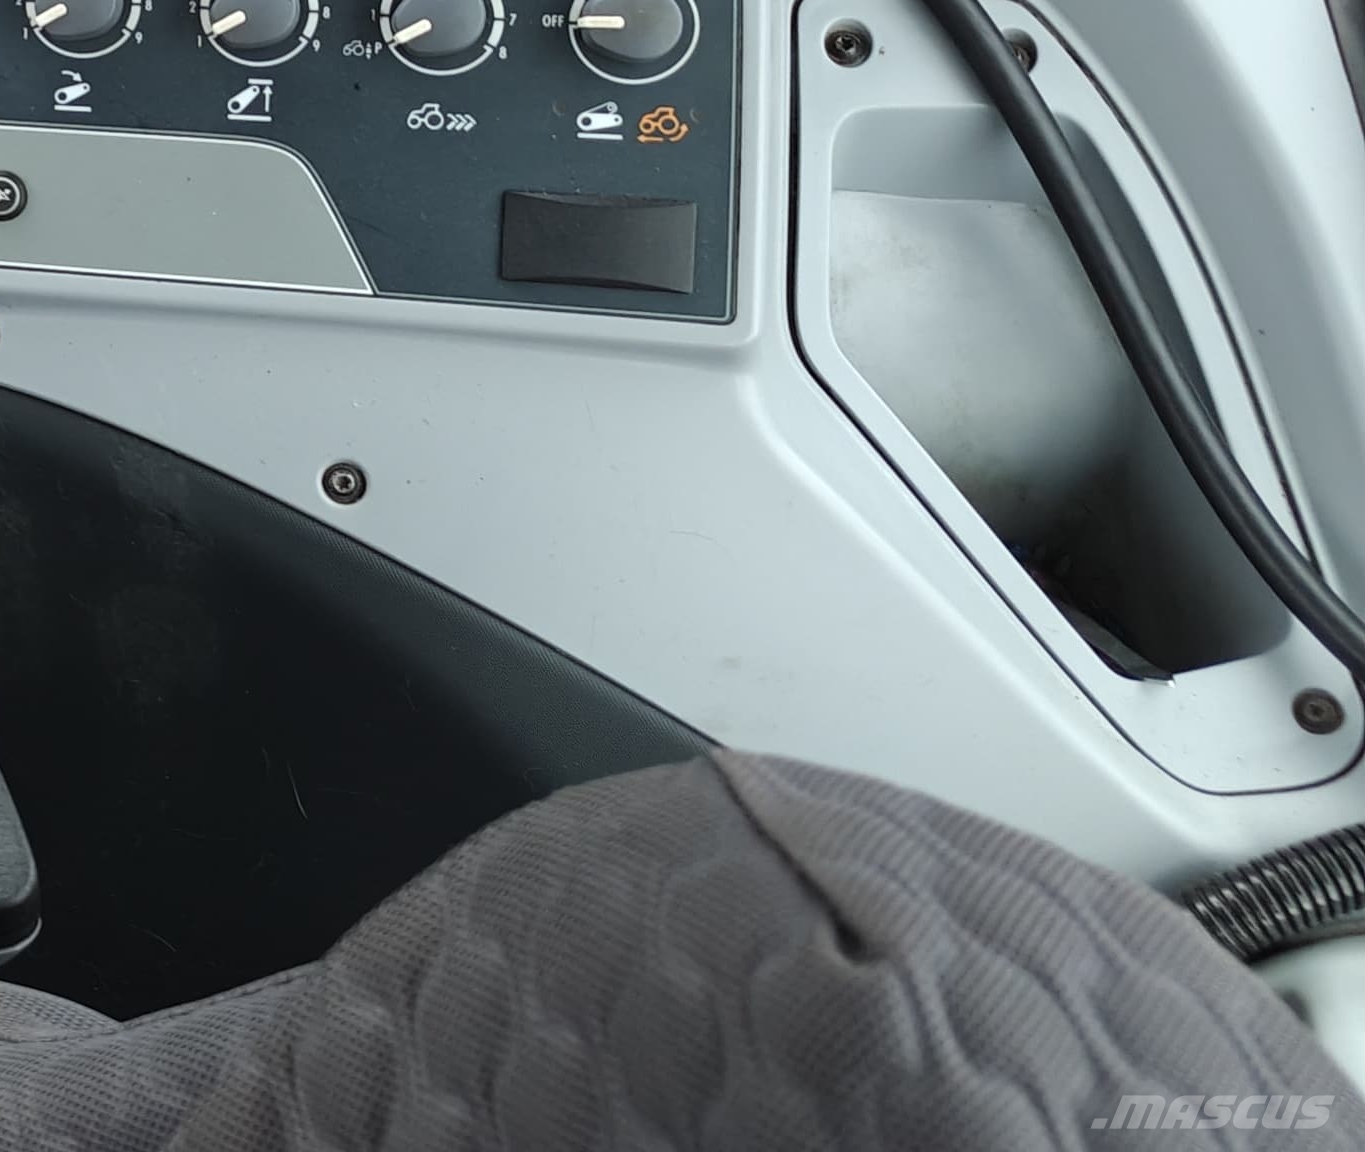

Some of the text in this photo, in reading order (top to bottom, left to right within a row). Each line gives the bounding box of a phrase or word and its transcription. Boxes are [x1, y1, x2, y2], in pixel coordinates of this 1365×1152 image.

[189, 0, 197, 13] 2
[322, 6, 331, 19] 8
[509, 13, 517, 26] 7
[541, 14, 565, 28] OFF
[135, 32, 143, 44] 9
[312, 40, 321, 52] 9
[374, 42, 383, 54] P
[499, 46, 508, 60] 8
